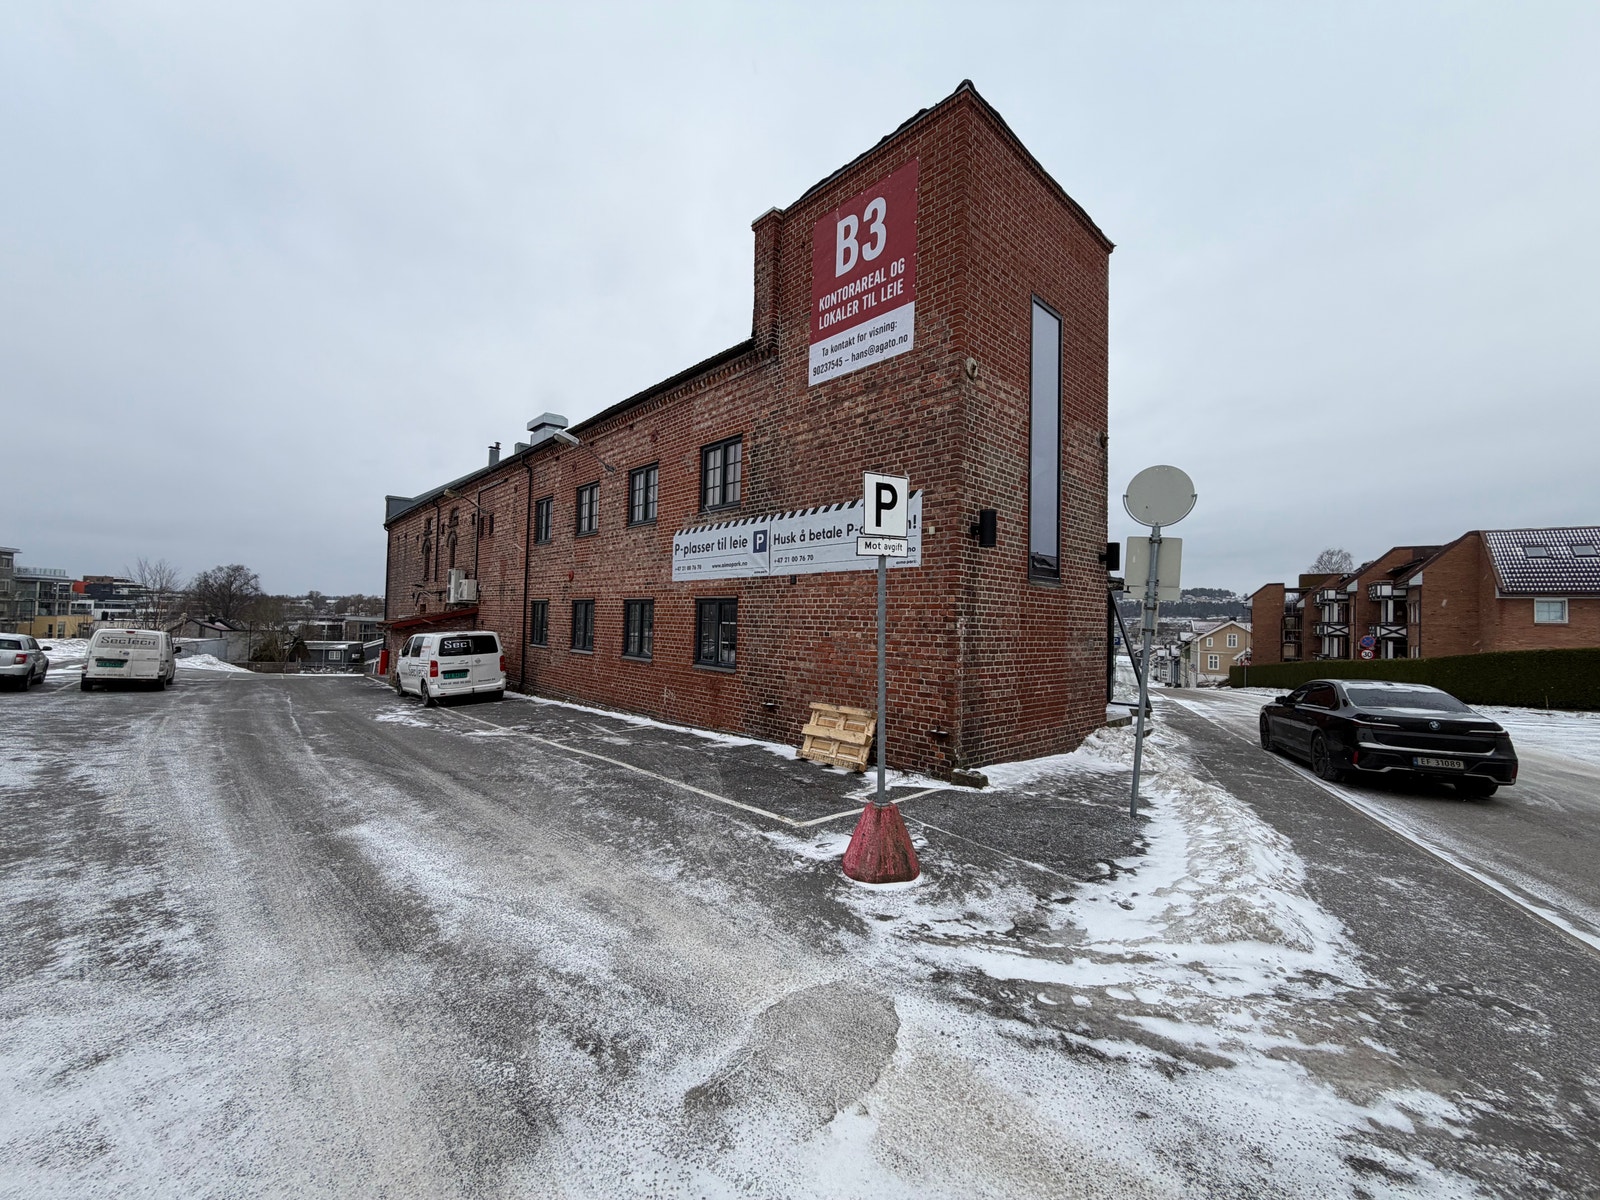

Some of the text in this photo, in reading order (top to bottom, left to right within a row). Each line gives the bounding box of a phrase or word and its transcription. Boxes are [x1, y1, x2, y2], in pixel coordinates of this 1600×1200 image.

[836, 197, 887, 278] B3
[819, 257, 905, 312] KONTORAREAL OG
[819, 278, 904, 330] LOKALER TIL LEIE
[812, 356, 843, 377] 90237545
[851, 333, 909, 363] hans@agato.no
[822, 320, 898, 357] Ta kontakt for visning:
[875, 482, 898, 527] P
[674, 534, 748, 558] P-plasser til leie
[756, 533, 764, 550] P
[773, 531, 796, 545] Husk
[799, 529, 806, 542] å
[809, 525, 843, 541] betale
[864, 541, 881, 550] Mot
[883, 542, 903, 553] avgift
[1435, 759, 1461, 768] 31089
